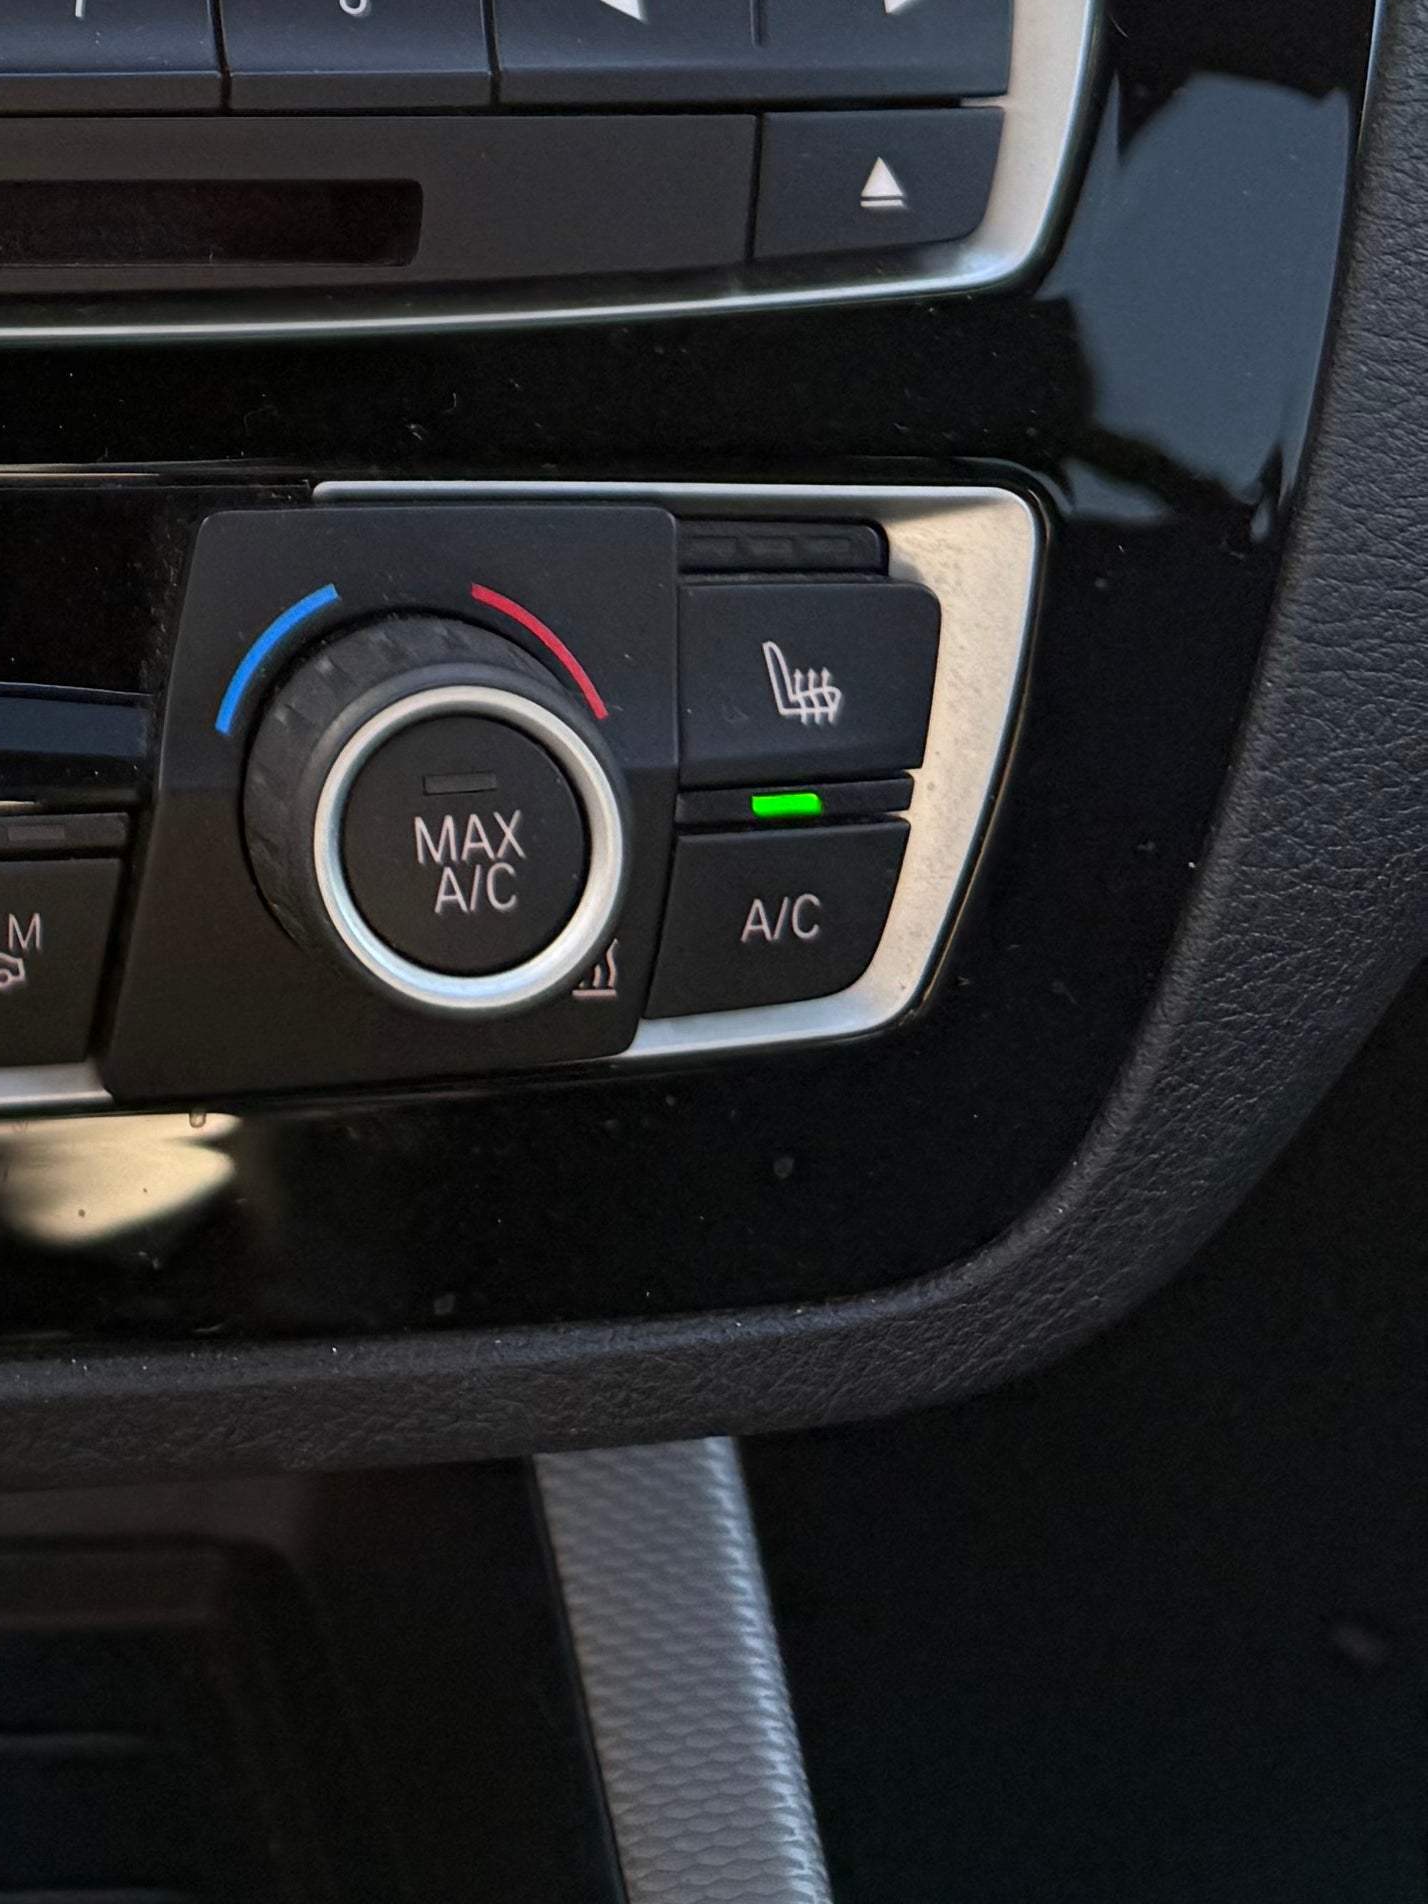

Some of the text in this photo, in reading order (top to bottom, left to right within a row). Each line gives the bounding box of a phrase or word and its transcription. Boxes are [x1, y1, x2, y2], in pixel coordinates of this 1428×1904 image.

[414, 810, 525, 864] MAX
[434, 861, 517, 914] A/C
[8, 912, 42, 950] M
[741, 893, 821, 942] A/C
